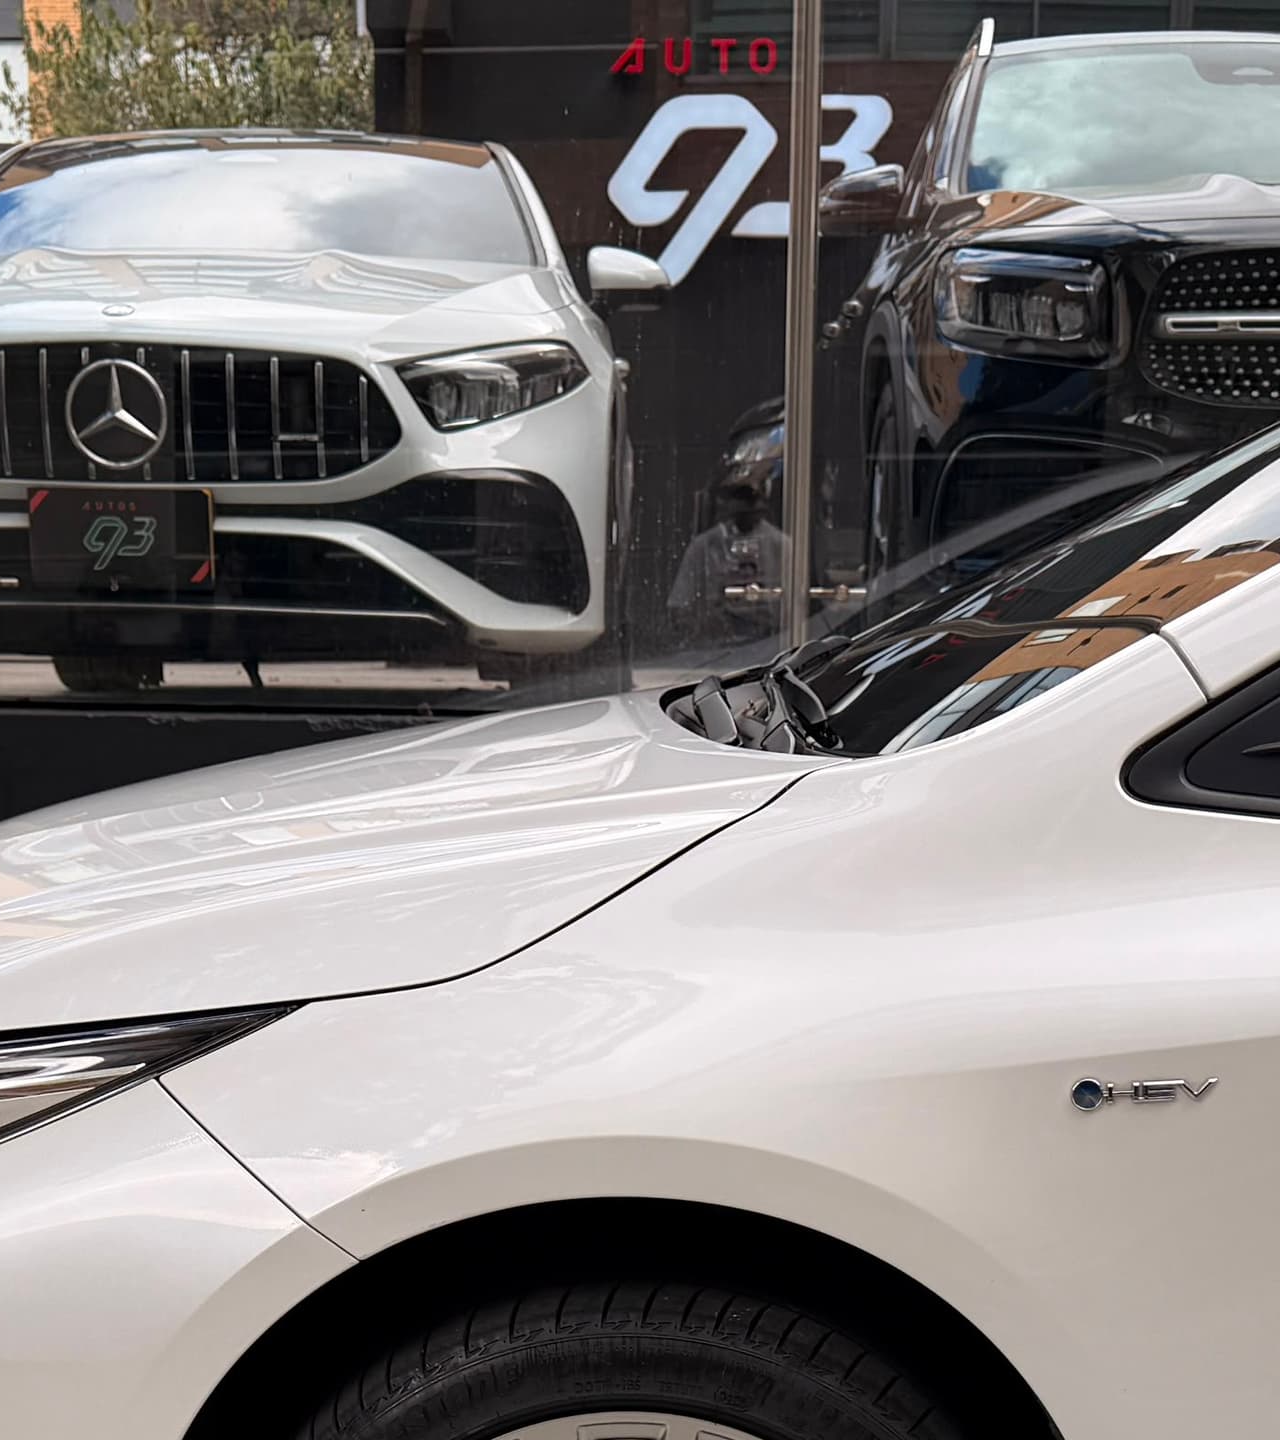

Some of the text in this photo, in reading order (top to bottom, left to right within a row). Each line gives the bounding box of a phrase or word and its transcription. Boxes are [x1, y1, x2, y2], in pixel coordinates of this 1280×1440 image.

[610, 37, 778, 75] AUTO
[607, 93, 893, 287] 93
[82, 501, 137, 512] AUTOS
[82, 516, 158, 571] 93
